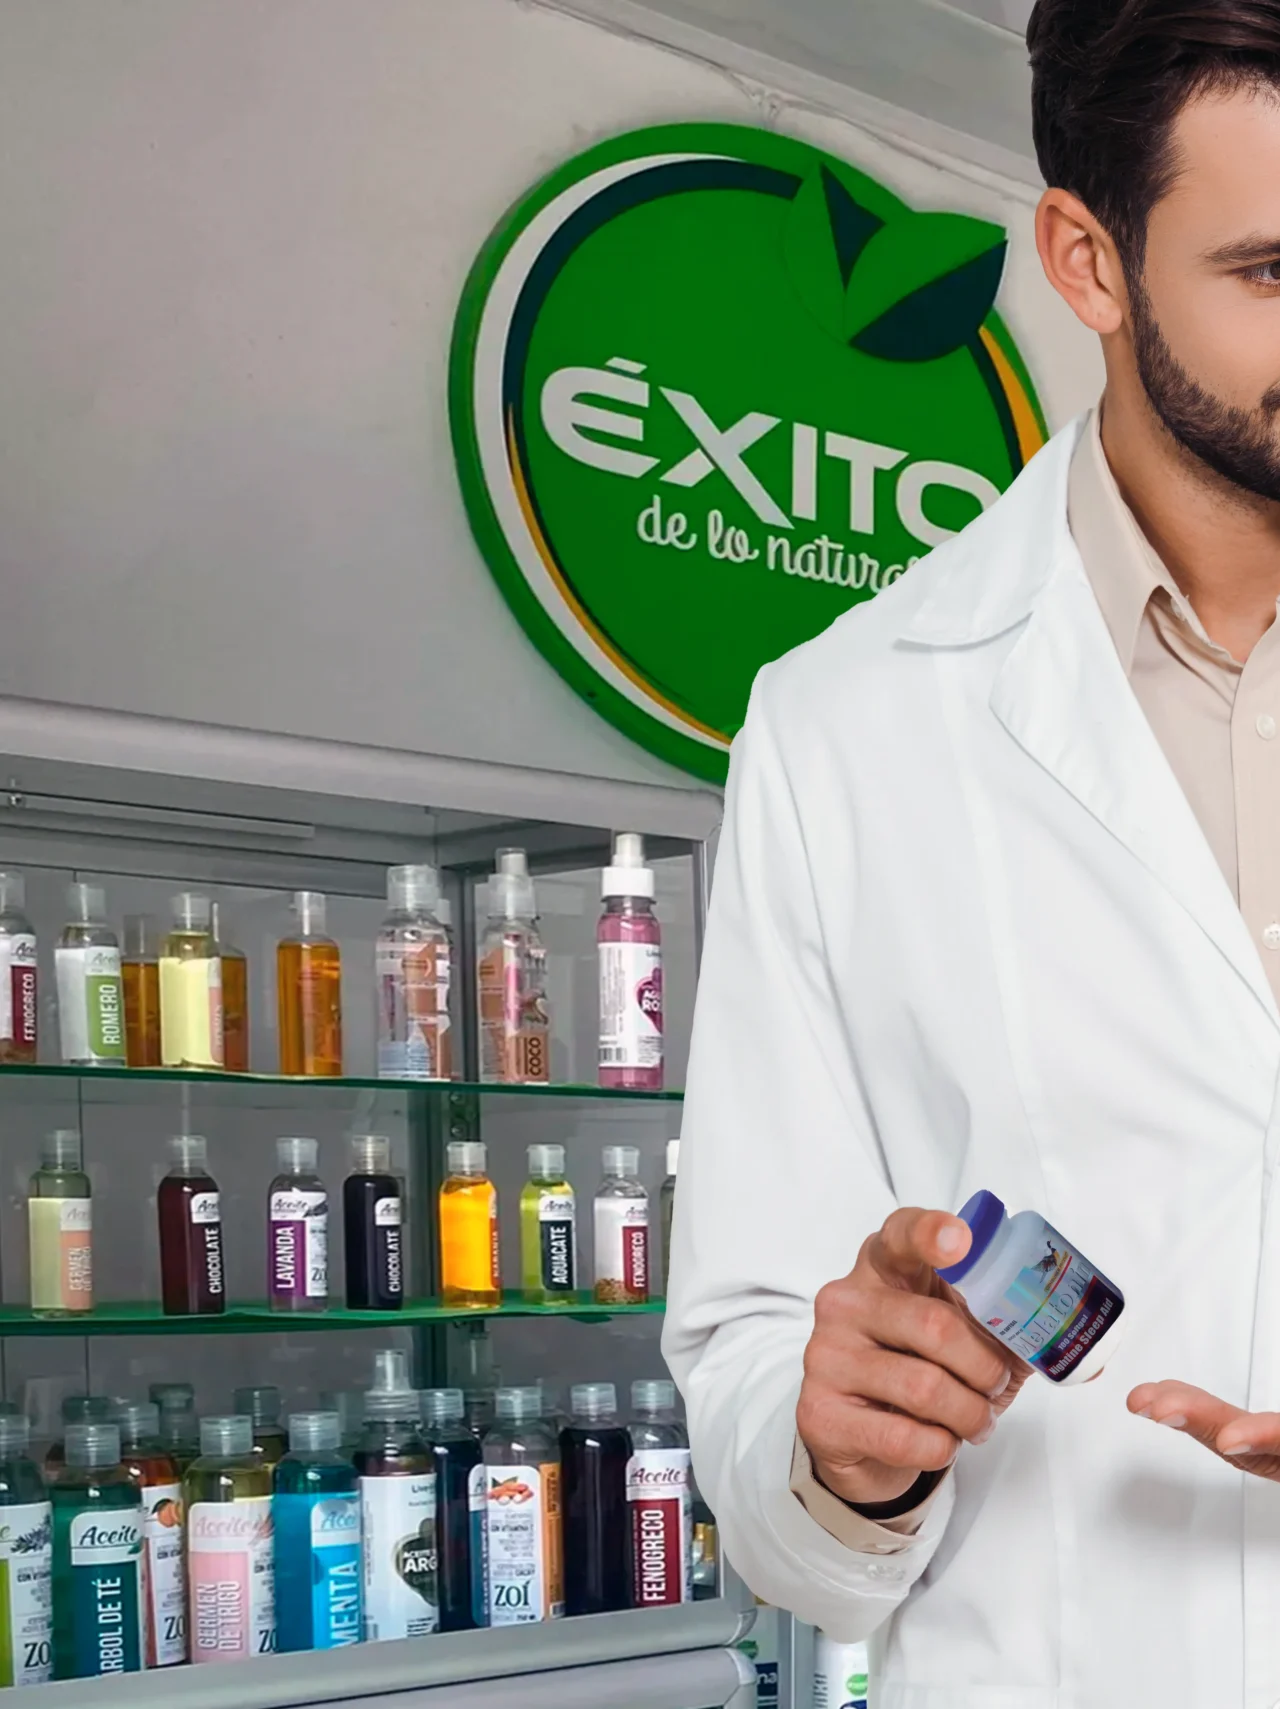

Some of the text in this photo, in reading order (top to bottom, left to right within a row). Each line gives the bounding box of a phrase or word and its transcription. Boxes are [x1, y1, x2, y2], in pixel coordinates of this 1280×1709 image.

[540, 356, 1002, 547] ÉXITO
[636, 494, 697, 550] de
[22, 973, 36, 1041] FENOGRECO
[99, 984, 121, 1045] ROMERO
[528, 1036, 542, 1076] COCO
[205, 1228, 222, 1294] CHOCOLATE
[275, 1226, 295, 1288] LAVANDA
[386, 1231, 400, 1293] CHOCOLATE
[550, 1226, 568, 1284] AGUACATE
[631, 1231, 645, 1288] FENOGRECO
[1010, 1260, 1094, 1358] Melatonin
[1057, 1314, 1089, 1351] 100 Softgel
[1079, 1315, 1105, 1346] Sleep
[1099, 1297, 1115, 1319] Aid
[631, 1467, 682, 1484] Aceite
[79, 1524, 138, 1547] Aceite
[640, 1509, 666, 1601] FENOGRECO
[91, 1576, 121, 1600] TÉ
[97, 1602, 122, 1624] DE
[197, 1583, 218, 1649] GERMEN
[218, 1581, 242, 1650] DE TRIGO
[24, 1641, 51, 1669] ZO
[164, 1616, 186, 1641] ZO
